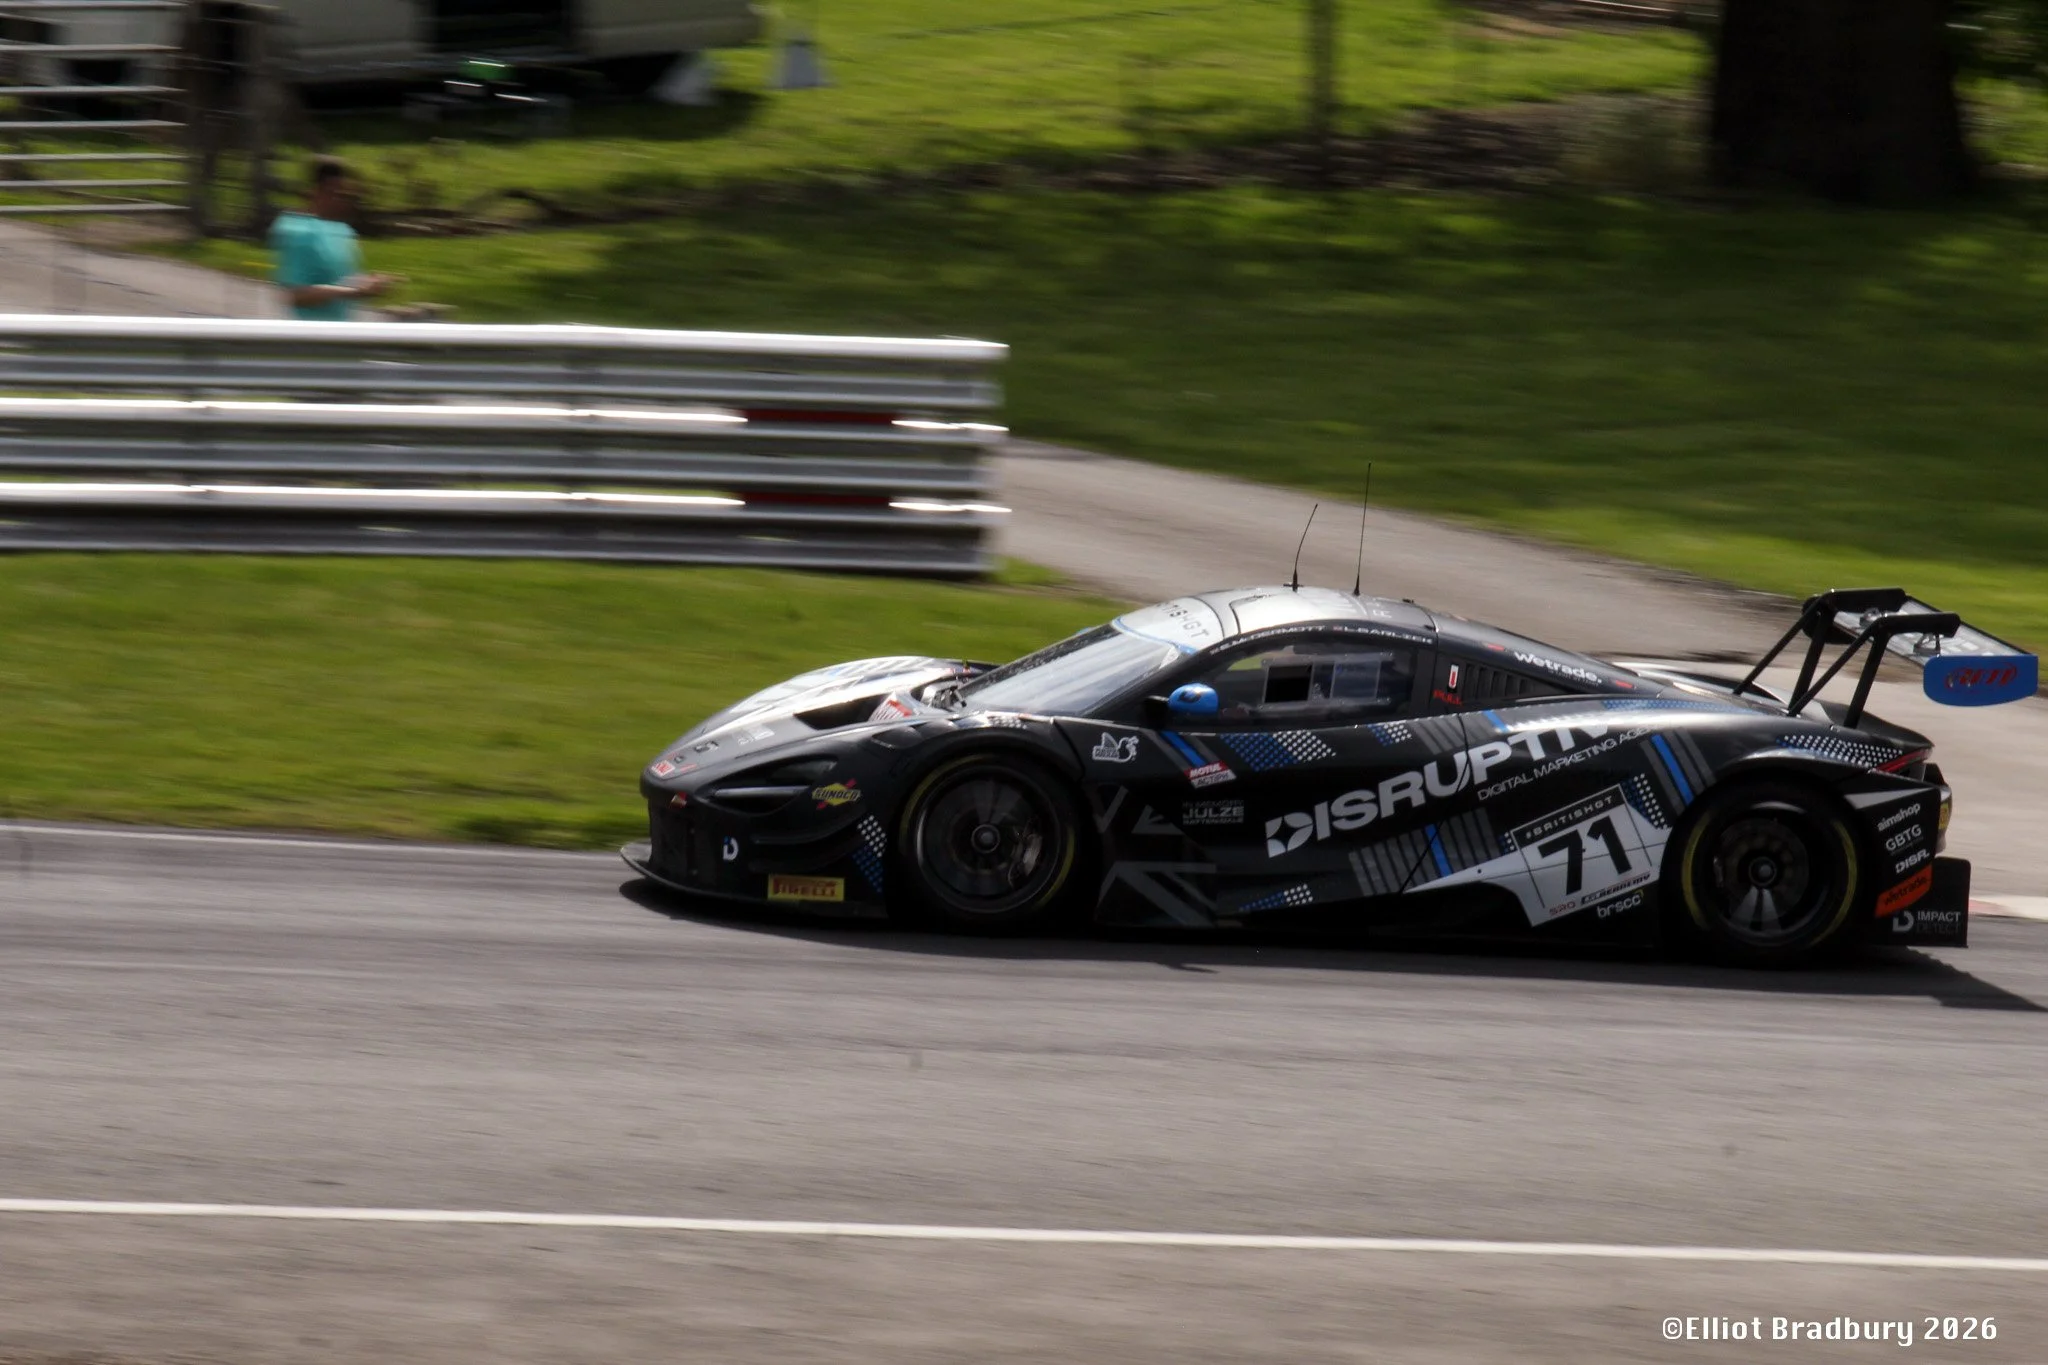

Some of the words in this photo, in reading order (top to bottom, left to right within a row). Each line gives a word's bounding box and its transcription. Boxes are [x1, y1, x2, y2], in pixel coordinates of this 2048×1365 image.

[1190, 762, 1222, 778] MOTUL
[1478, 774, 1534, 801] DIGITAL
[1534, 738, 1617, 780] MARKETING
[813, 788, 861, 802] SUNOCO
[1265, 714, 1612, 858] DISRUPTIV
[1182, 806, 1244, 819] JULZE
[1877, 803, 1921, 832] aimshop
[1885, 824, 1922, 851] GBTG
[1537, 815, 1632, 896] 71
[773, 877, 839, 897] PIRELLI
[1597, 894, 1643, 918] brscc
[1917, 911, 1961, 922] IMPACT
